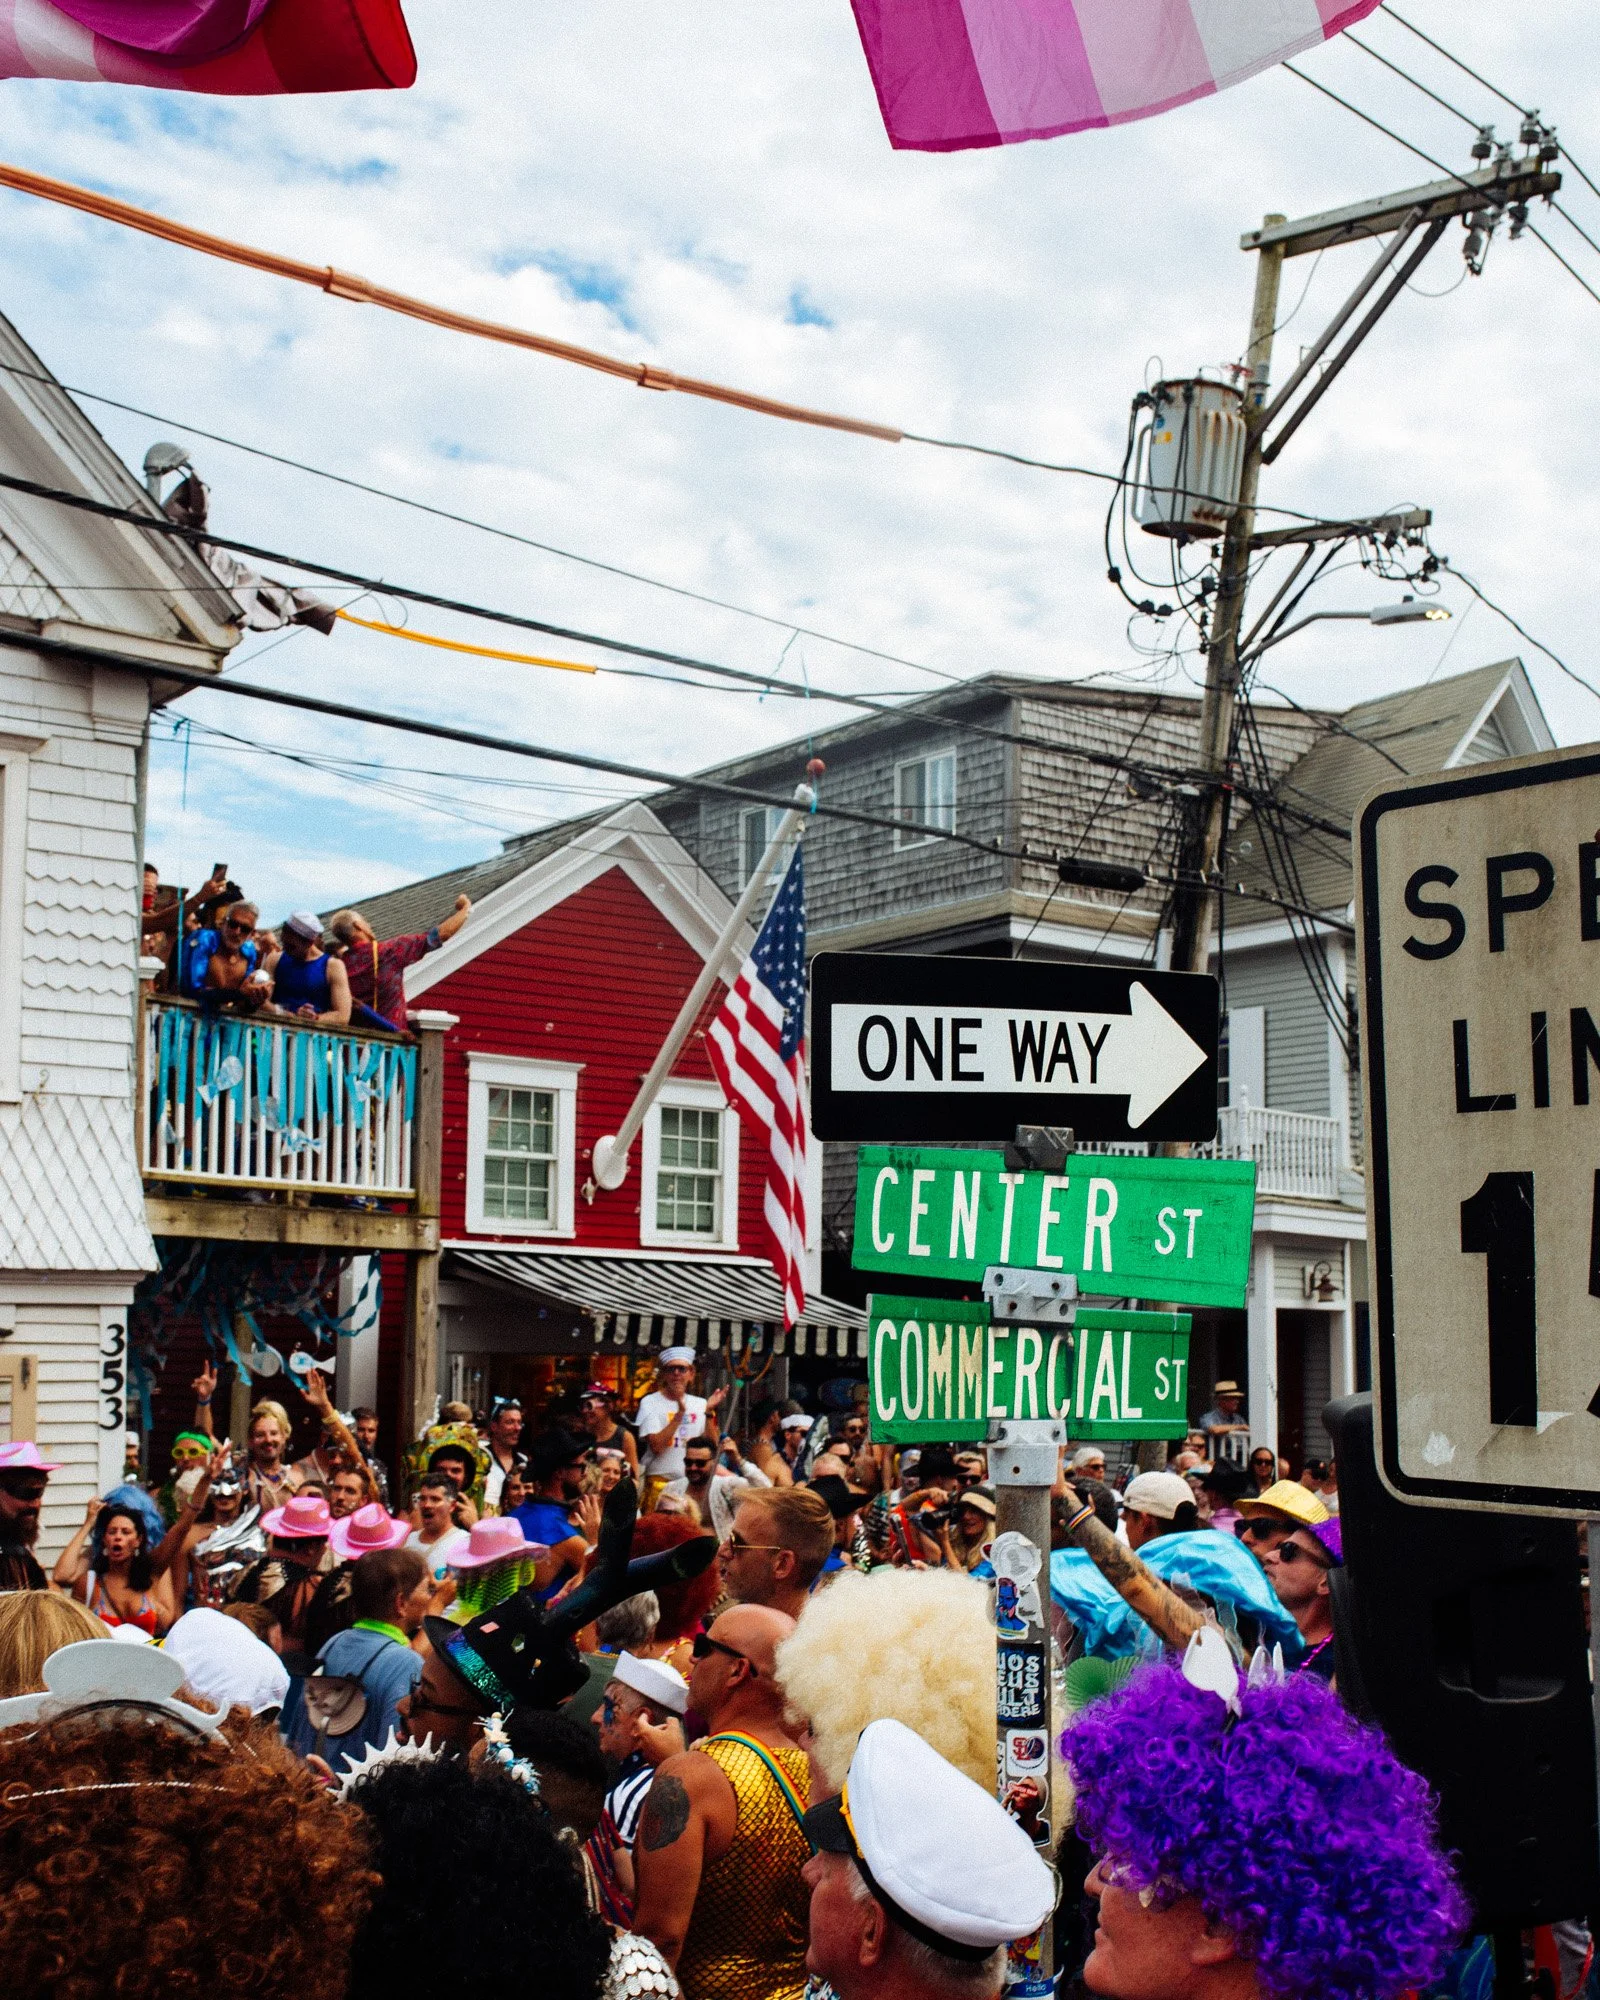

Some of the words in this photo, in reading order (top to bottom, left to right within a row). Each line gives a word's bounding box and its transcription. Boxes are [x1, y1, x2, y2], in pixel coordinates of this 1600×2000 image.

[858, 1015, 984, 1082] ONE
[1008, 1019, 1112, 1084] WAY
[871, 1166, 1118, 1273] CENTER
[1154, 1206, 1203, 1259] ST
[1460, 1169, 1600, 1427] 1
[99, 1323, 125, 1431] 353
[874, 1318, 1142, 1422] COMMERCIAL
[1154, 1358, 1186, 1403] ST
